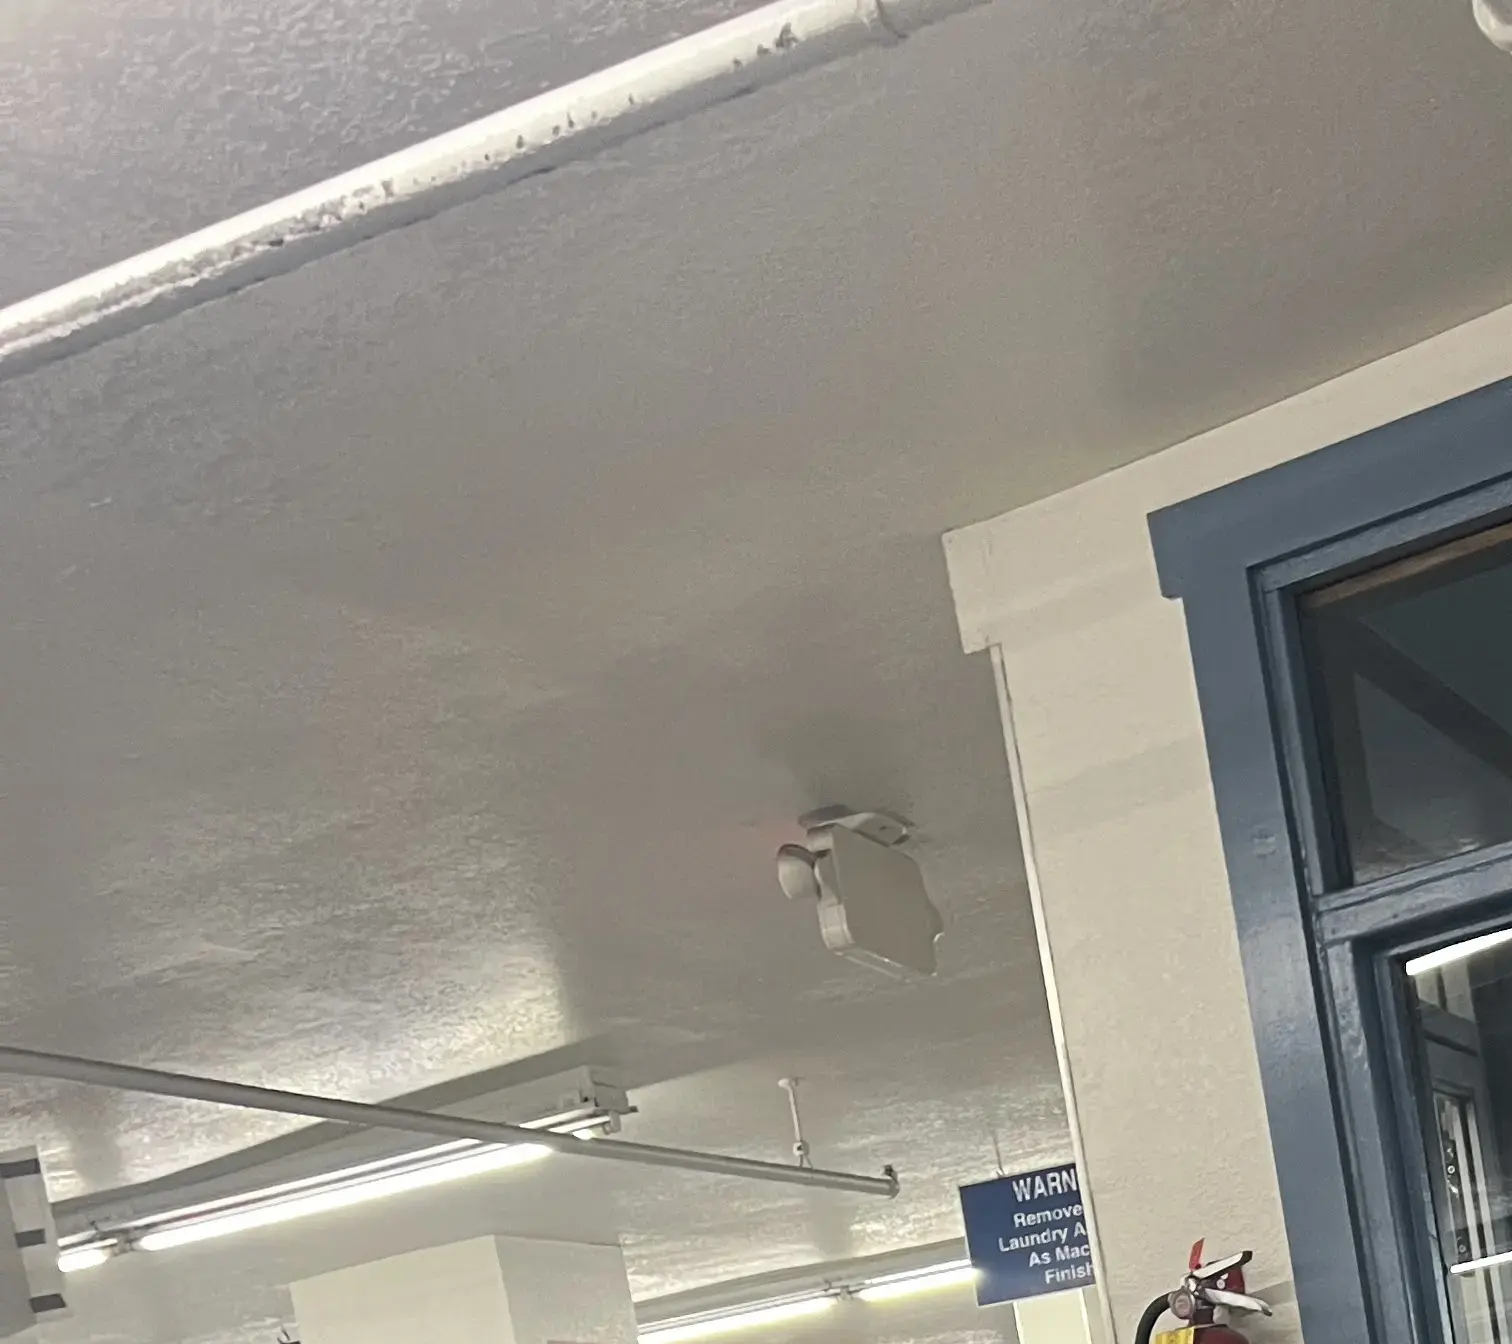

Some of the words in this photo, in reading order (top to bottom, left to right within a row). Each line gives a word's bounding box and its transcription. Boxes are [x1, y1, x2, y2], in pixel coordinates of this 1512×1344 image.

[1012, 1168, 1077, 1202] WARN
[1013, 1204, 1082, 1228] Remove
[998, 1227, 1068, 1252] Laundry
[1029, 1251, 1051, 1267] As
[1055, 1244, 1090, 1261] Mac
